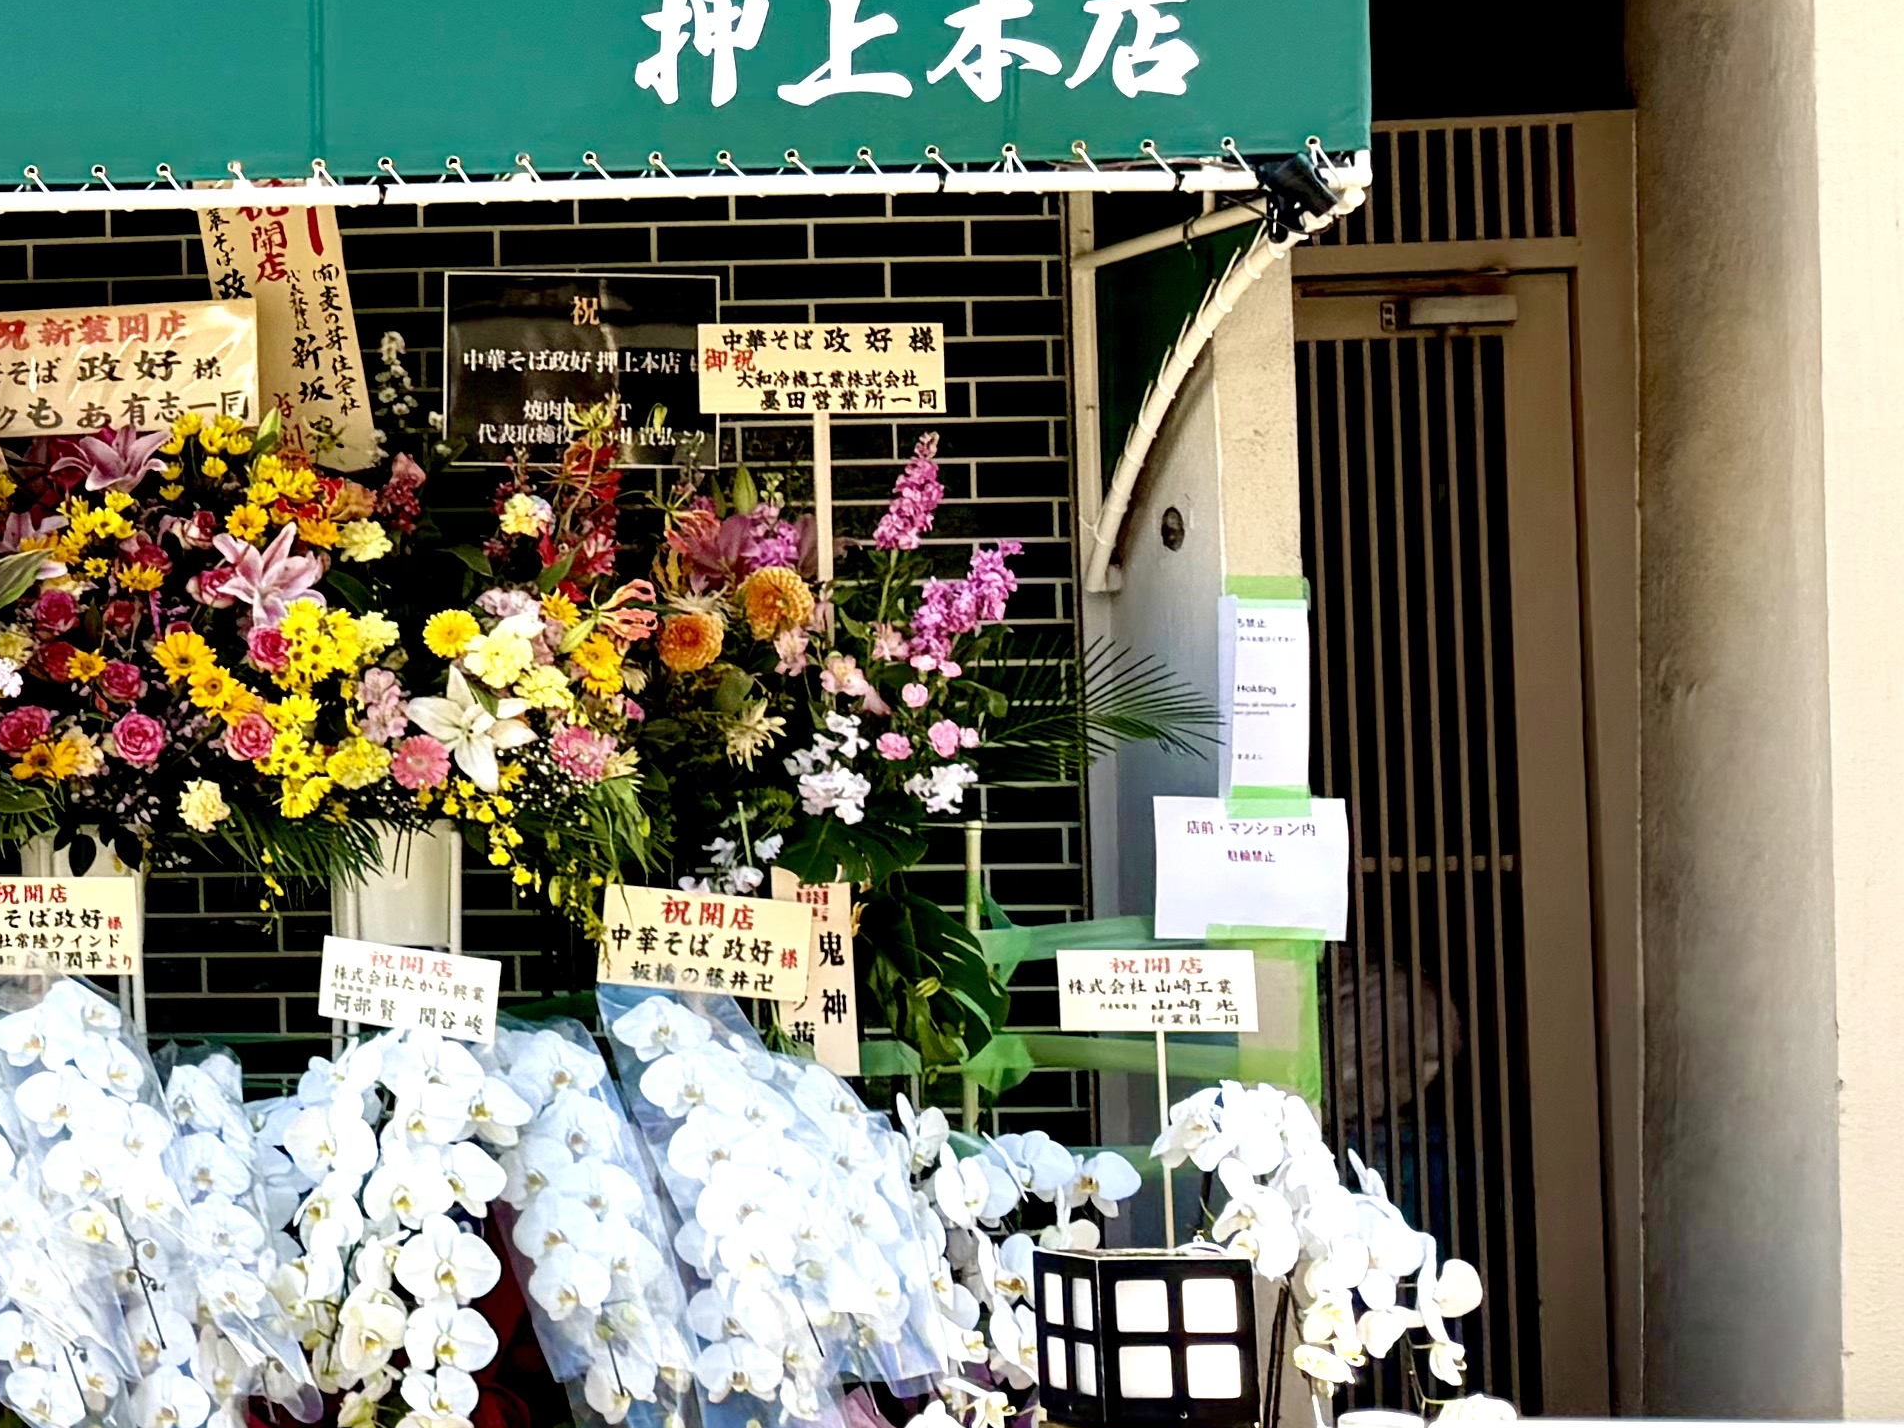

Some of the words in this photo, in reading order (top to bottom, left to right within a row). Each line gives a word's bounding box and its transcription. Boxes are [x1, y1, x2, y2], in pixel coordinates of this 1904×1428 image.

[570, 296, 600, 325] 祝
[722, 329, 814, 352] 中華そば
[77, 349, 182, 382] 政好
[192, 356, 223, 380] 様
[596, 352, 680, 373] 押上本店
[704, 348, 756, 373] 御祝
[736, 370, 920, 389] 大和冷機工業株式会社
[760, 390, 938, 412] 墨田営業所一同
[1187, 821, 1316, 837] 店前・マンション内
[660, 895, 755, 931] 祝開店
[611, 924, 714, 958] 中華そば
[780, 947, 798, 969] 様
[370, 950, 453, 978] 祝開店
[1110, 957, 1204, 974] 祝開店
[819, 931, 847, 1024] 鬼神
